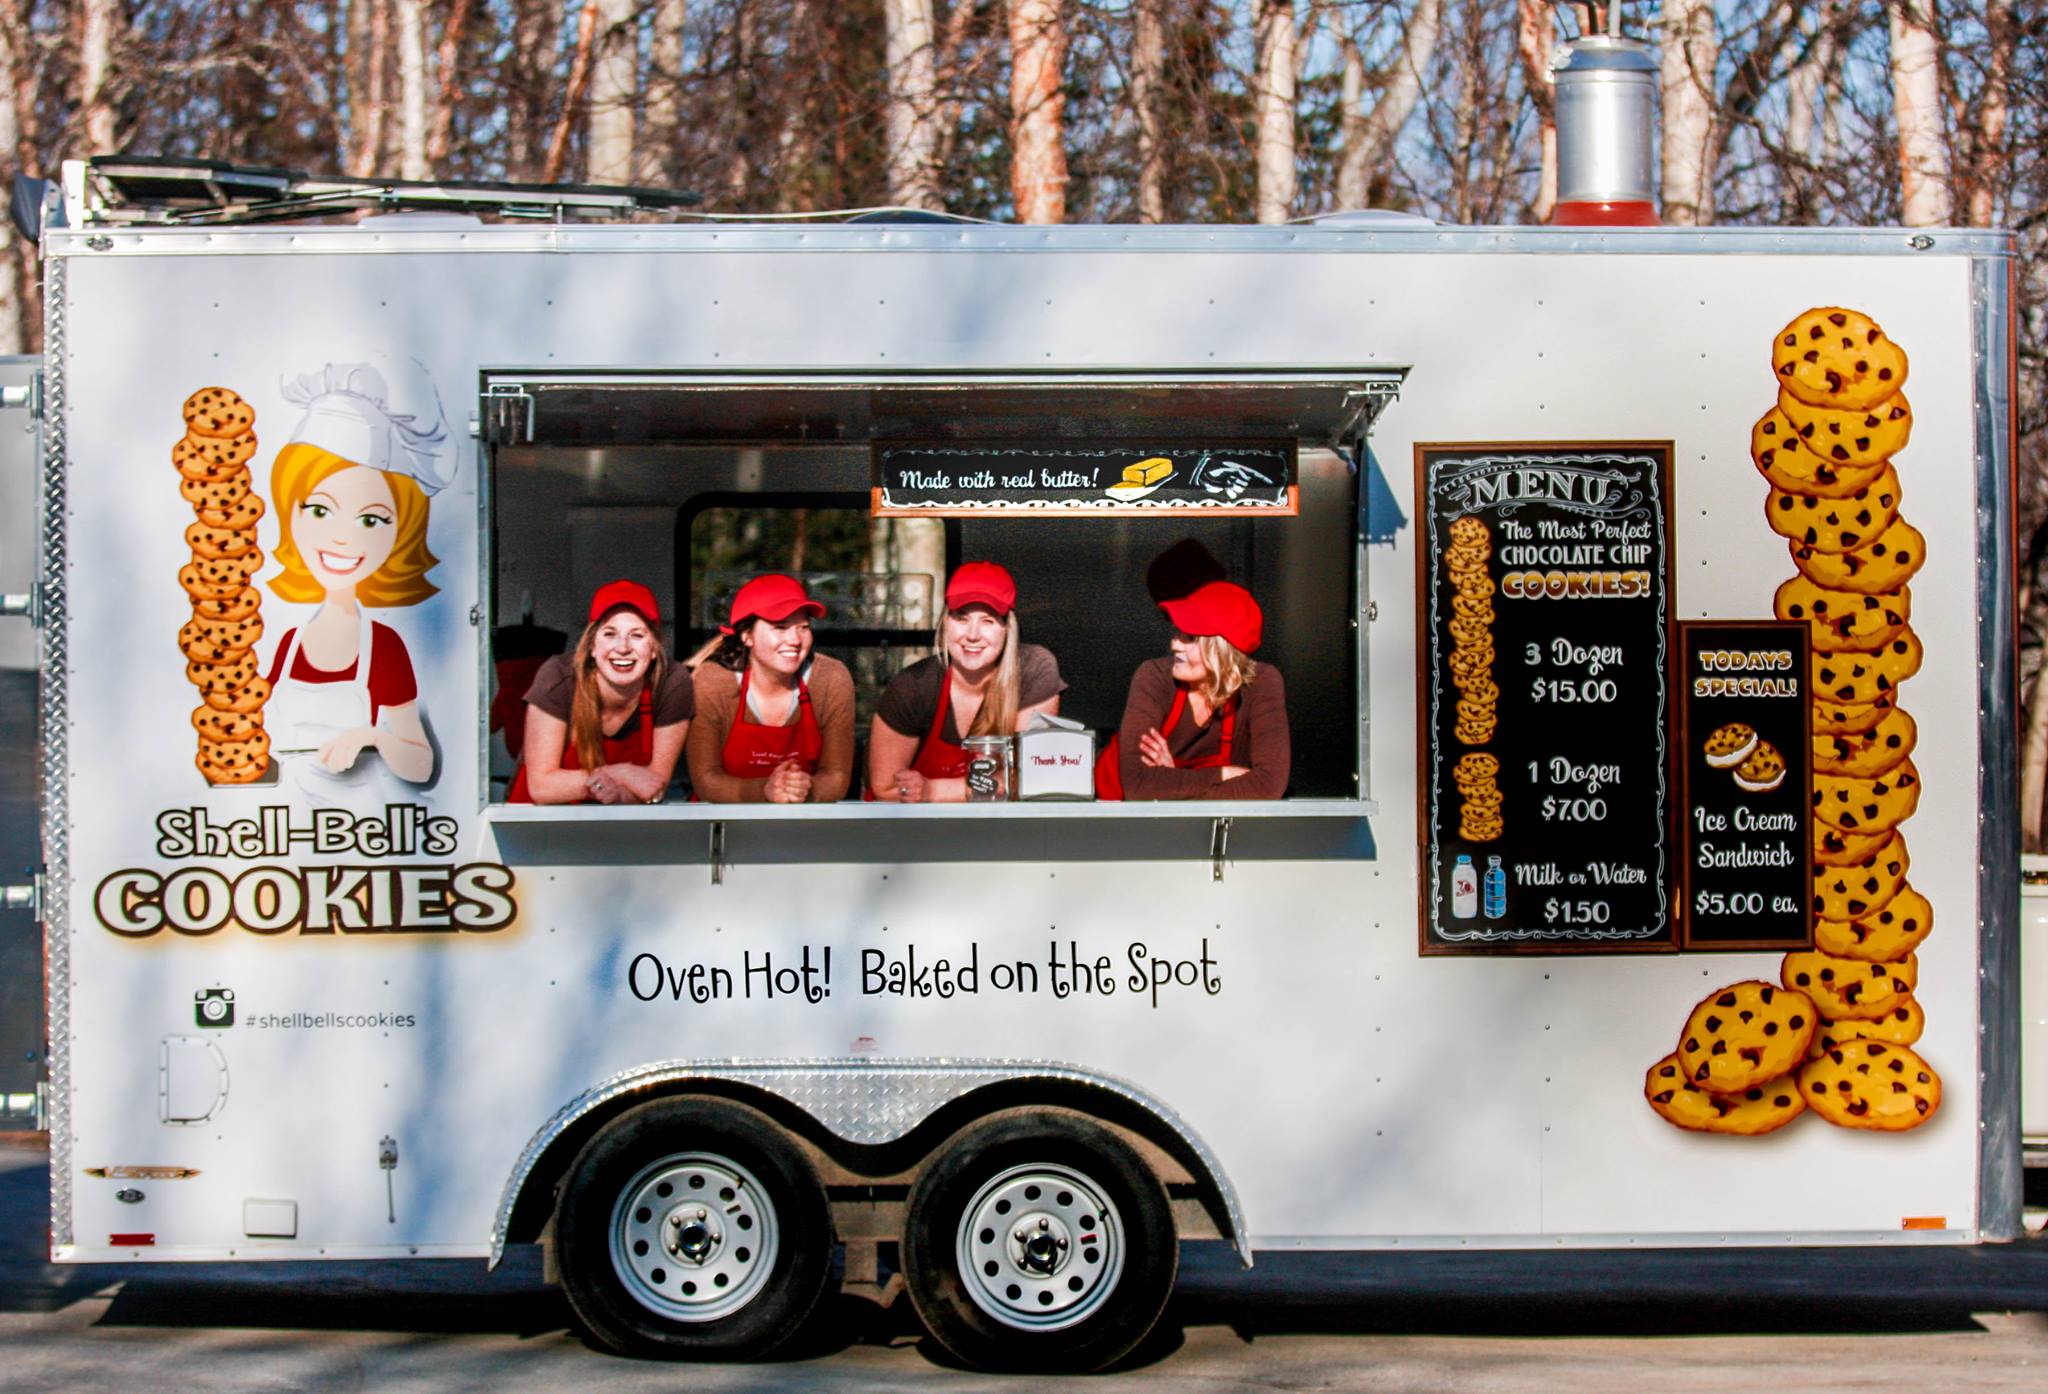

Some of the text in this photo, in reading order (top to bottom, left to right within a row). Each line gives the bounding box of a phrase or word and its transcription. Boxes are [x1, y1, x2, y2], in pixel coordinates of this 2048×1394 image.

[899, 467, 1100, 489] Made with real butter!
[1470, 469, 1610, 507] MENU
[1501, 520, 1652, 545] The Most Perfect
[1501, 545, 1652, 565] CHOCOLATE CHIP
[1501, 570, 1652, 599] COOKIES!
[1525, 638, 1623, 675] 3 Dozen
[1700, 651, 1793, 672] TODAYS
[1532, 677, 1617, 703] $15.00
[1695, 677, 1798, 698] SPECIAL!
[1528, 757, 1620, 794] 1 Dozen
[1542, 796, 1607, 822] $7.00
[1695, 806, 1796, 832] Ice Cream
[157, 804, 458, 858] Shell-Bell's
[1699, 842, 1794, 868] Sandwich
[1516, 863, 1647, 886] Milk or Water
[94, 862, 518, 938] COOKIES
[1544, 898, 1610, 923] $1.50
[1697, 891, 1798, 915] $5.00 ea.
[627, 937, 1222, 1009] Oven Hot! Baked on the Spot
[245, 1011, 416, 1029] #shellbellscookies
